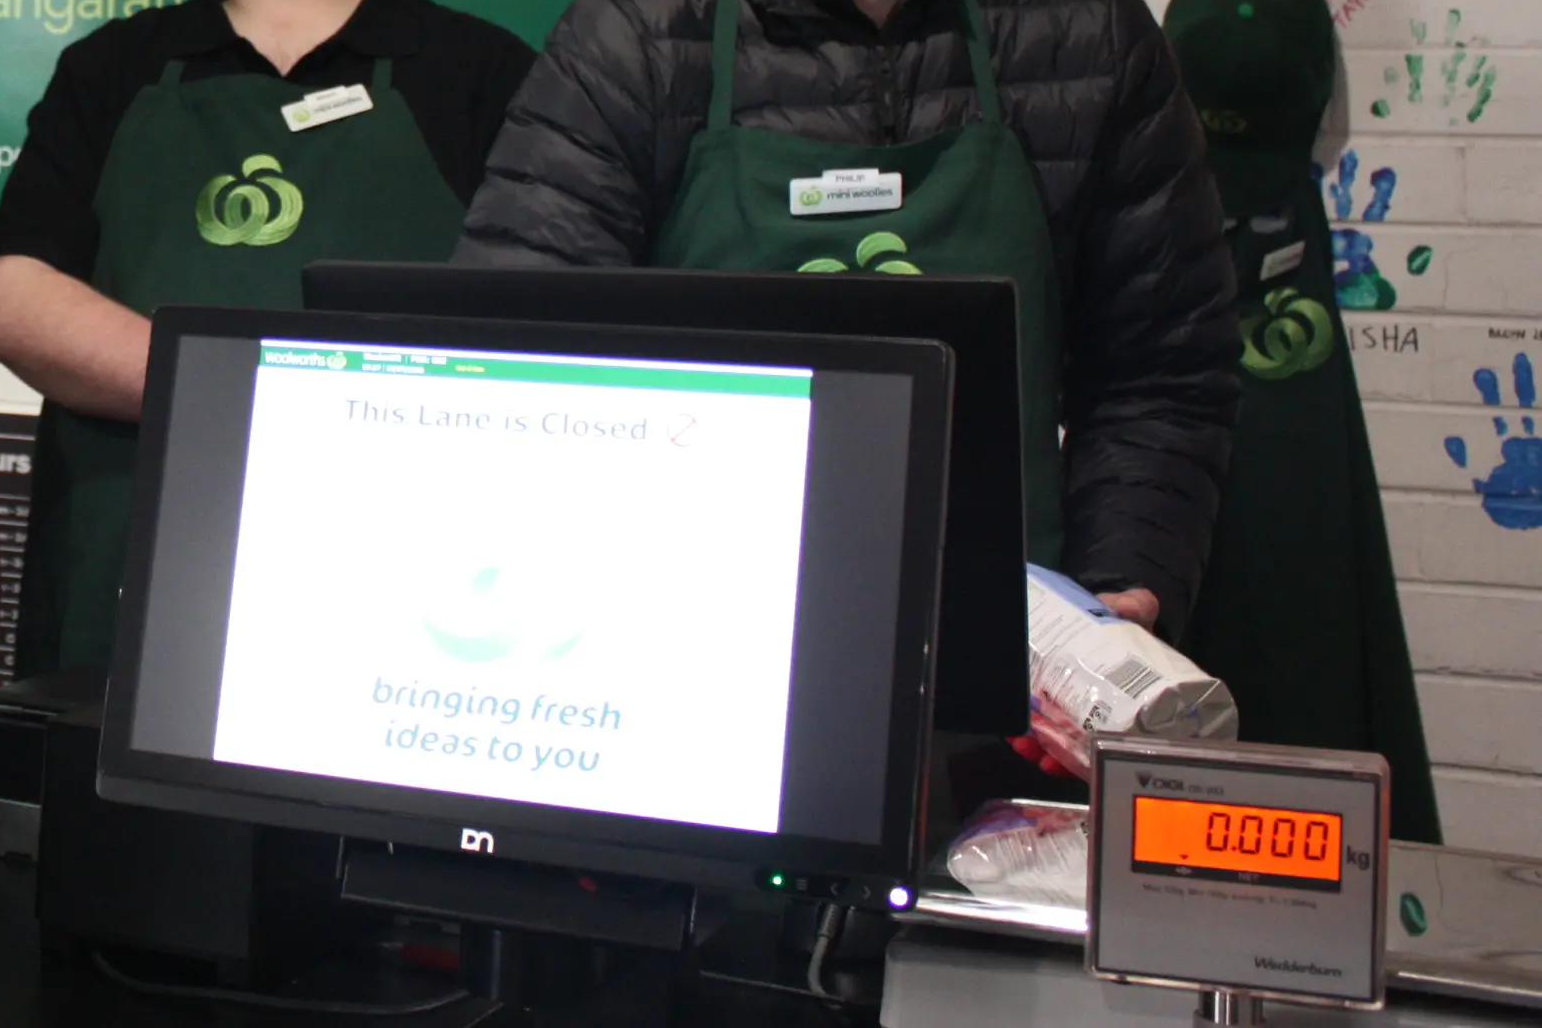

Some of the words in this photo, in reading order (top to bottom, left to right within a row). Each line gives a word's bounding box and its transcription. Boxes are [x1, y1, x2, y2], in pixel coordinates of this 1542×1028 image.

[826, 188, 851, 200] mini
[852, 186, 894, 199] woolies
[834, 173, 866, 183] PHILIP
[345, 399, 405, 424] This
[418, 404, 491, 430] Lane
[505, 409, 529, 432] is
[541, 412, 648, 441] Closed
[371, 676, 521, 725] bringing
[530, 694, 622, 730] fresh
[384, 719, 479, 757] ideas
[487, 735, 524, 762] to
[529, 744, 600, 772] you
[1206, 811, 1329, 861] 0.000
[1346, 843, 1370, 871] kg
